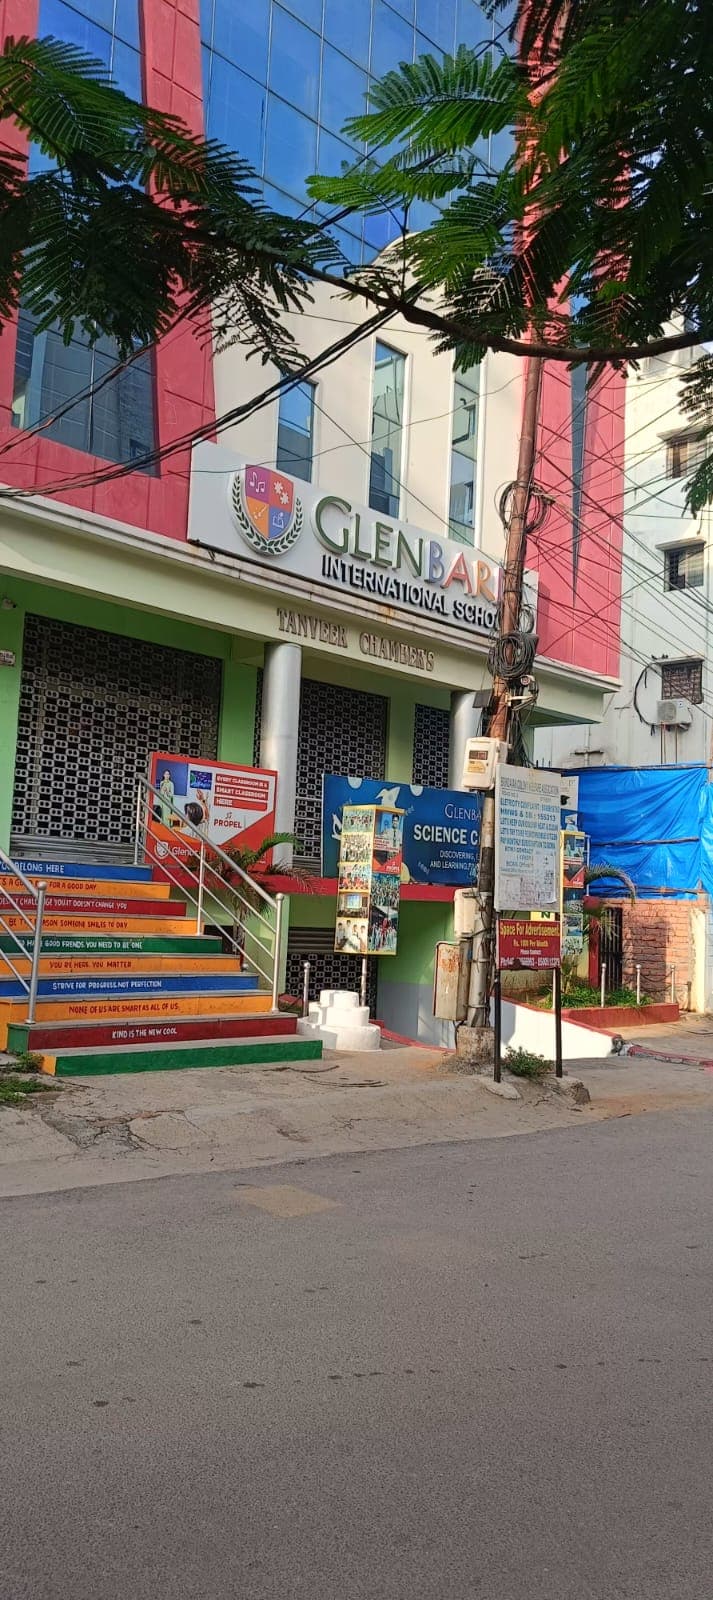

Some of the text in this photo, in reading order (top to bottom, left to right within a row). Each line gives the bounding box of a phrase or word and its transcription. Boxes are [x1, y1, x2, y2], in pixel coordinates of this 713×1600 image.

[311, 494, 504, 606] GLENBAR
[321, 554, 498, 629] INTERNATIONAL SCHO
[277, 608, 434, 671] TANVEER CHAMBERS
[216, 775, 231, 783] EVERY
[232, 778, 258, 787] CLASSROOM
[216, 787, 266, 799] SMART CLASSROOM
[216, 798, 233, 806] HERE
[445, 803, 481, 821] GLENBA
[214, 818, 243, 829] PROPEL
[414, 824, 467, 845] SCIENCE
[471, 830, 479, 845] C
[46, 864, 65, 873] HERE
[430, 860, 441, 868] AND
[50, 881, 61, 889] FOR
[67, 882, 84, 890] GOOD
[9, 919, 17, 927] BE
[500, 922, 560, 938] Space For Advertisement
[45, 940, 61, 948] GOOD
[86, 941, 97, 949] YOU
[98, 941, 113, 949] NEED
[131, 941, 143, 950] ONE
[49, 961, 63, 969] YOU
[92, 961, 104, 969] YOU
[107, 961, 132, 969] MATTER
[53, 982, 75, 990] STRIVE
[118, 981, 129, 989] NOT
[131, 980, 162, 988] PERFECTION
[69, 1005, 88, 1014] NONE
[90, 1005, 98, 1013] OF
[99, 1005, 107, 1013] US
[109, 1005, 120, 1013] ARE
[121, 1004, 141, 1012] SMART
[150, 1003, 160, 1011] ALL
[161, 1002, 169, 1010] OF
[112, 1027, 178, 1039] KIND IS THE NEW COOL
